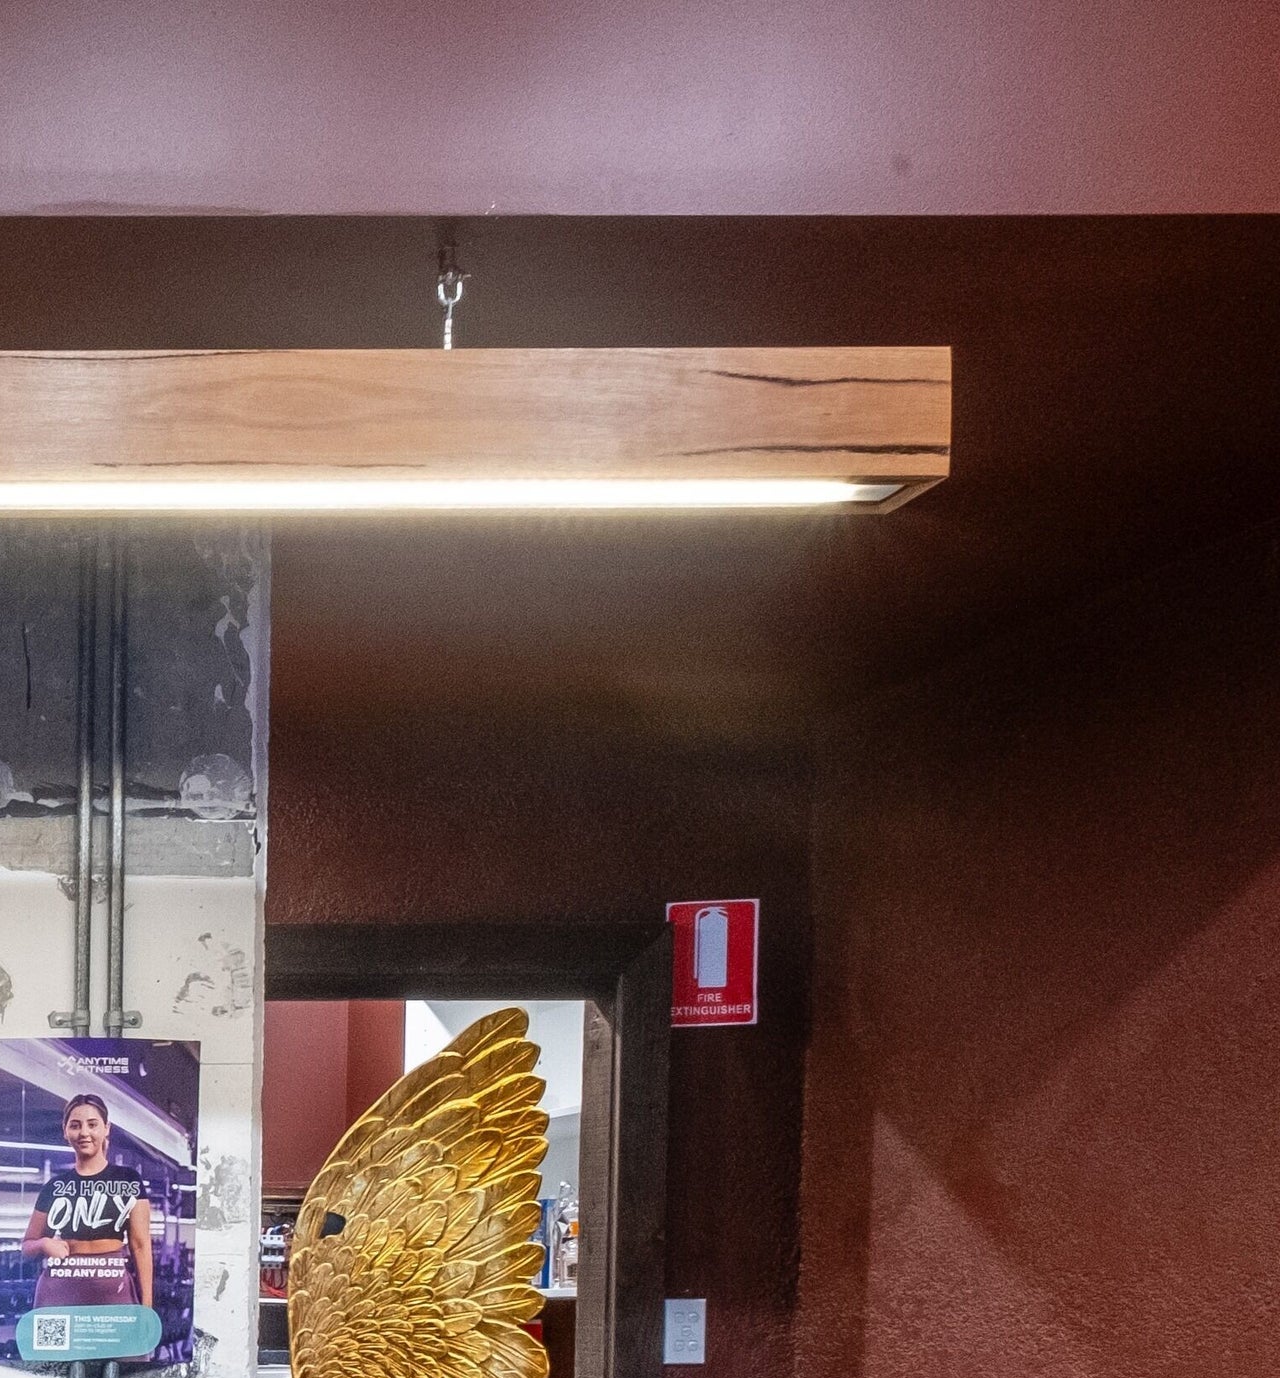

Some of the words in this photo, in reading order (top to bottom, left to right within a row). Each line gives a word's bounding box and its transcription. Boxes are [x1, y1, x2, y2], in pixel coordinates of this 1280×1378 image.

[697, 993, 723, 1003] FIRE
[670, 1004, 752, 1017] EXTINGUISHER
[76, 1057, 129, 1065] ANYTIME
[76, 1065, 130, 1074] FITNESS
[53, 1180, 77, 1196] 24
[80, 1180, 141, 1197] HOURS
[47, 1191, 138, 1232] ONLY
[47, 1257, 61, 1267] $0
[62, 1258, 107, 1267] JOINING
[50, 1269, 72, 1278] FOR
[72, 1269, 96, 1278] ANY
[97, 1269, 125, 1278] BODY
[91, 1315, 138, 1323] WEDNESDAY
